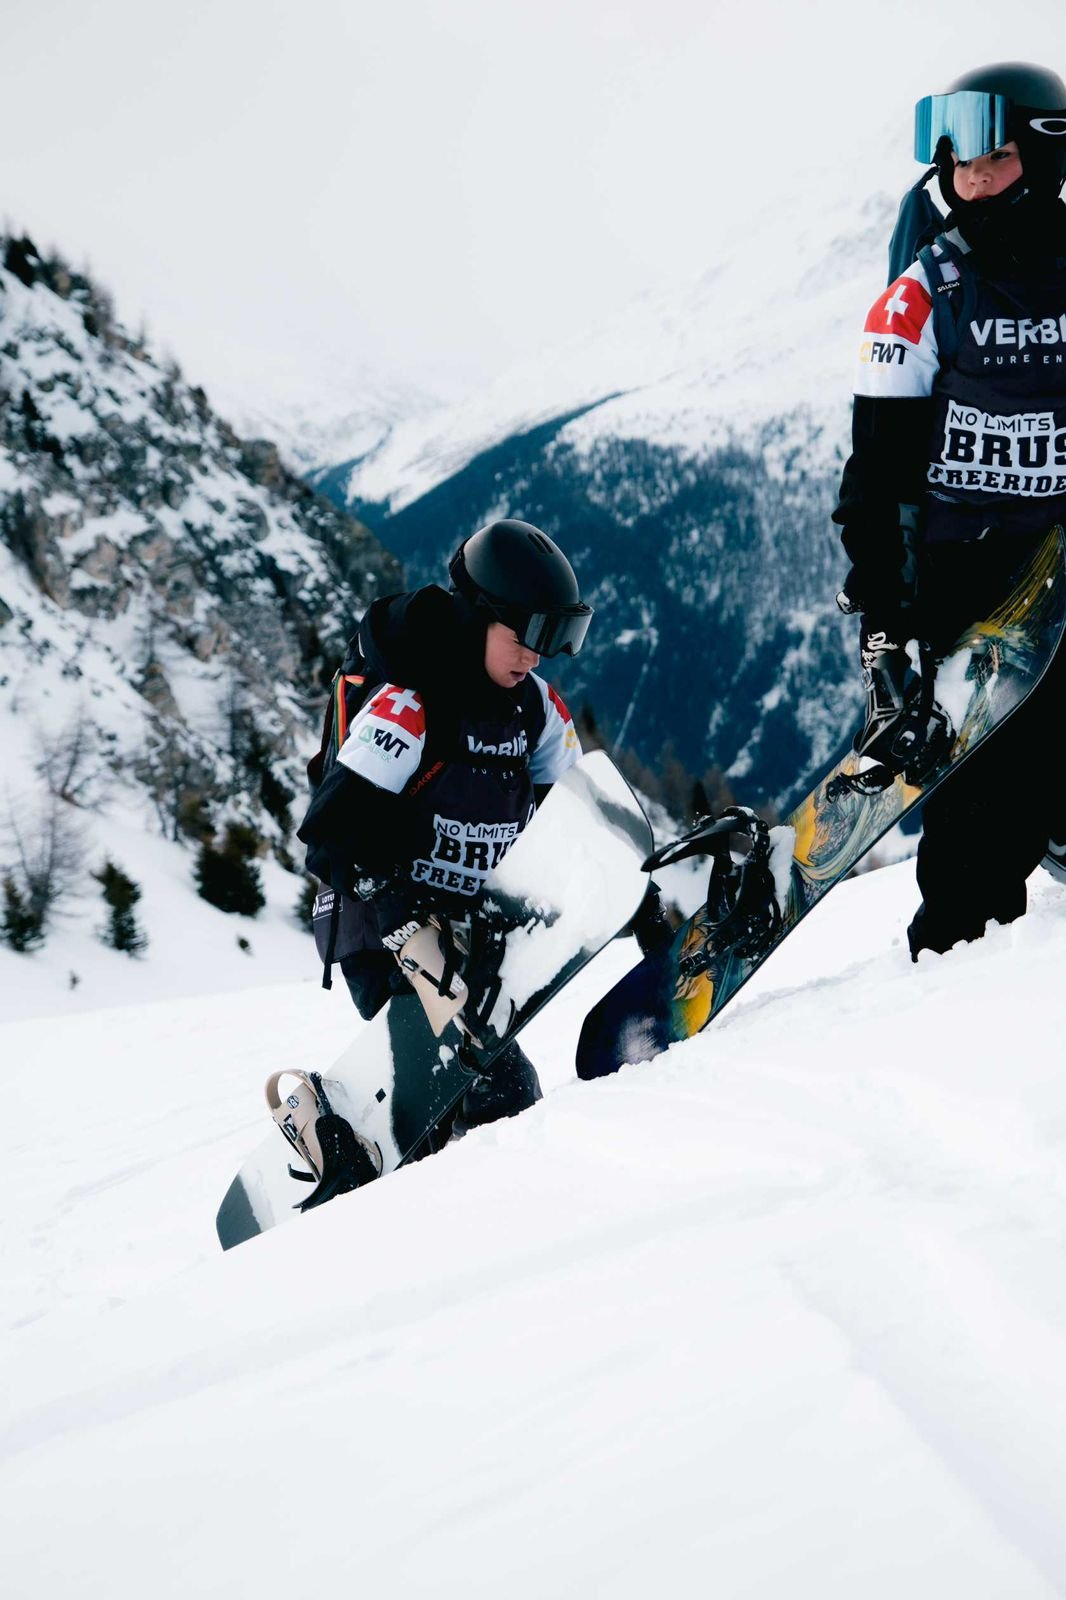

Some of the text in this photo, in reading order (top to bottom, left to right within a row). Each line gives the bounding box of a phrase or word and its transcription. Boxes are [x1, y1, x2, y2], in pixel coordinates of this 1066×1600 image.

[870, 341, 909, 365] FWT
[983, 354, 1062, 365] PURE EN
[950, 408, 1050, 433] NO LIMITS
[930, 465, 1066, 493] FREERIDE
[374, 728, 411, 759] FWT
[437, 821, 516, 839] NO LIMITS
[435, 834, 519, 871] BRU
[414, 862, 486, 893] FREE
